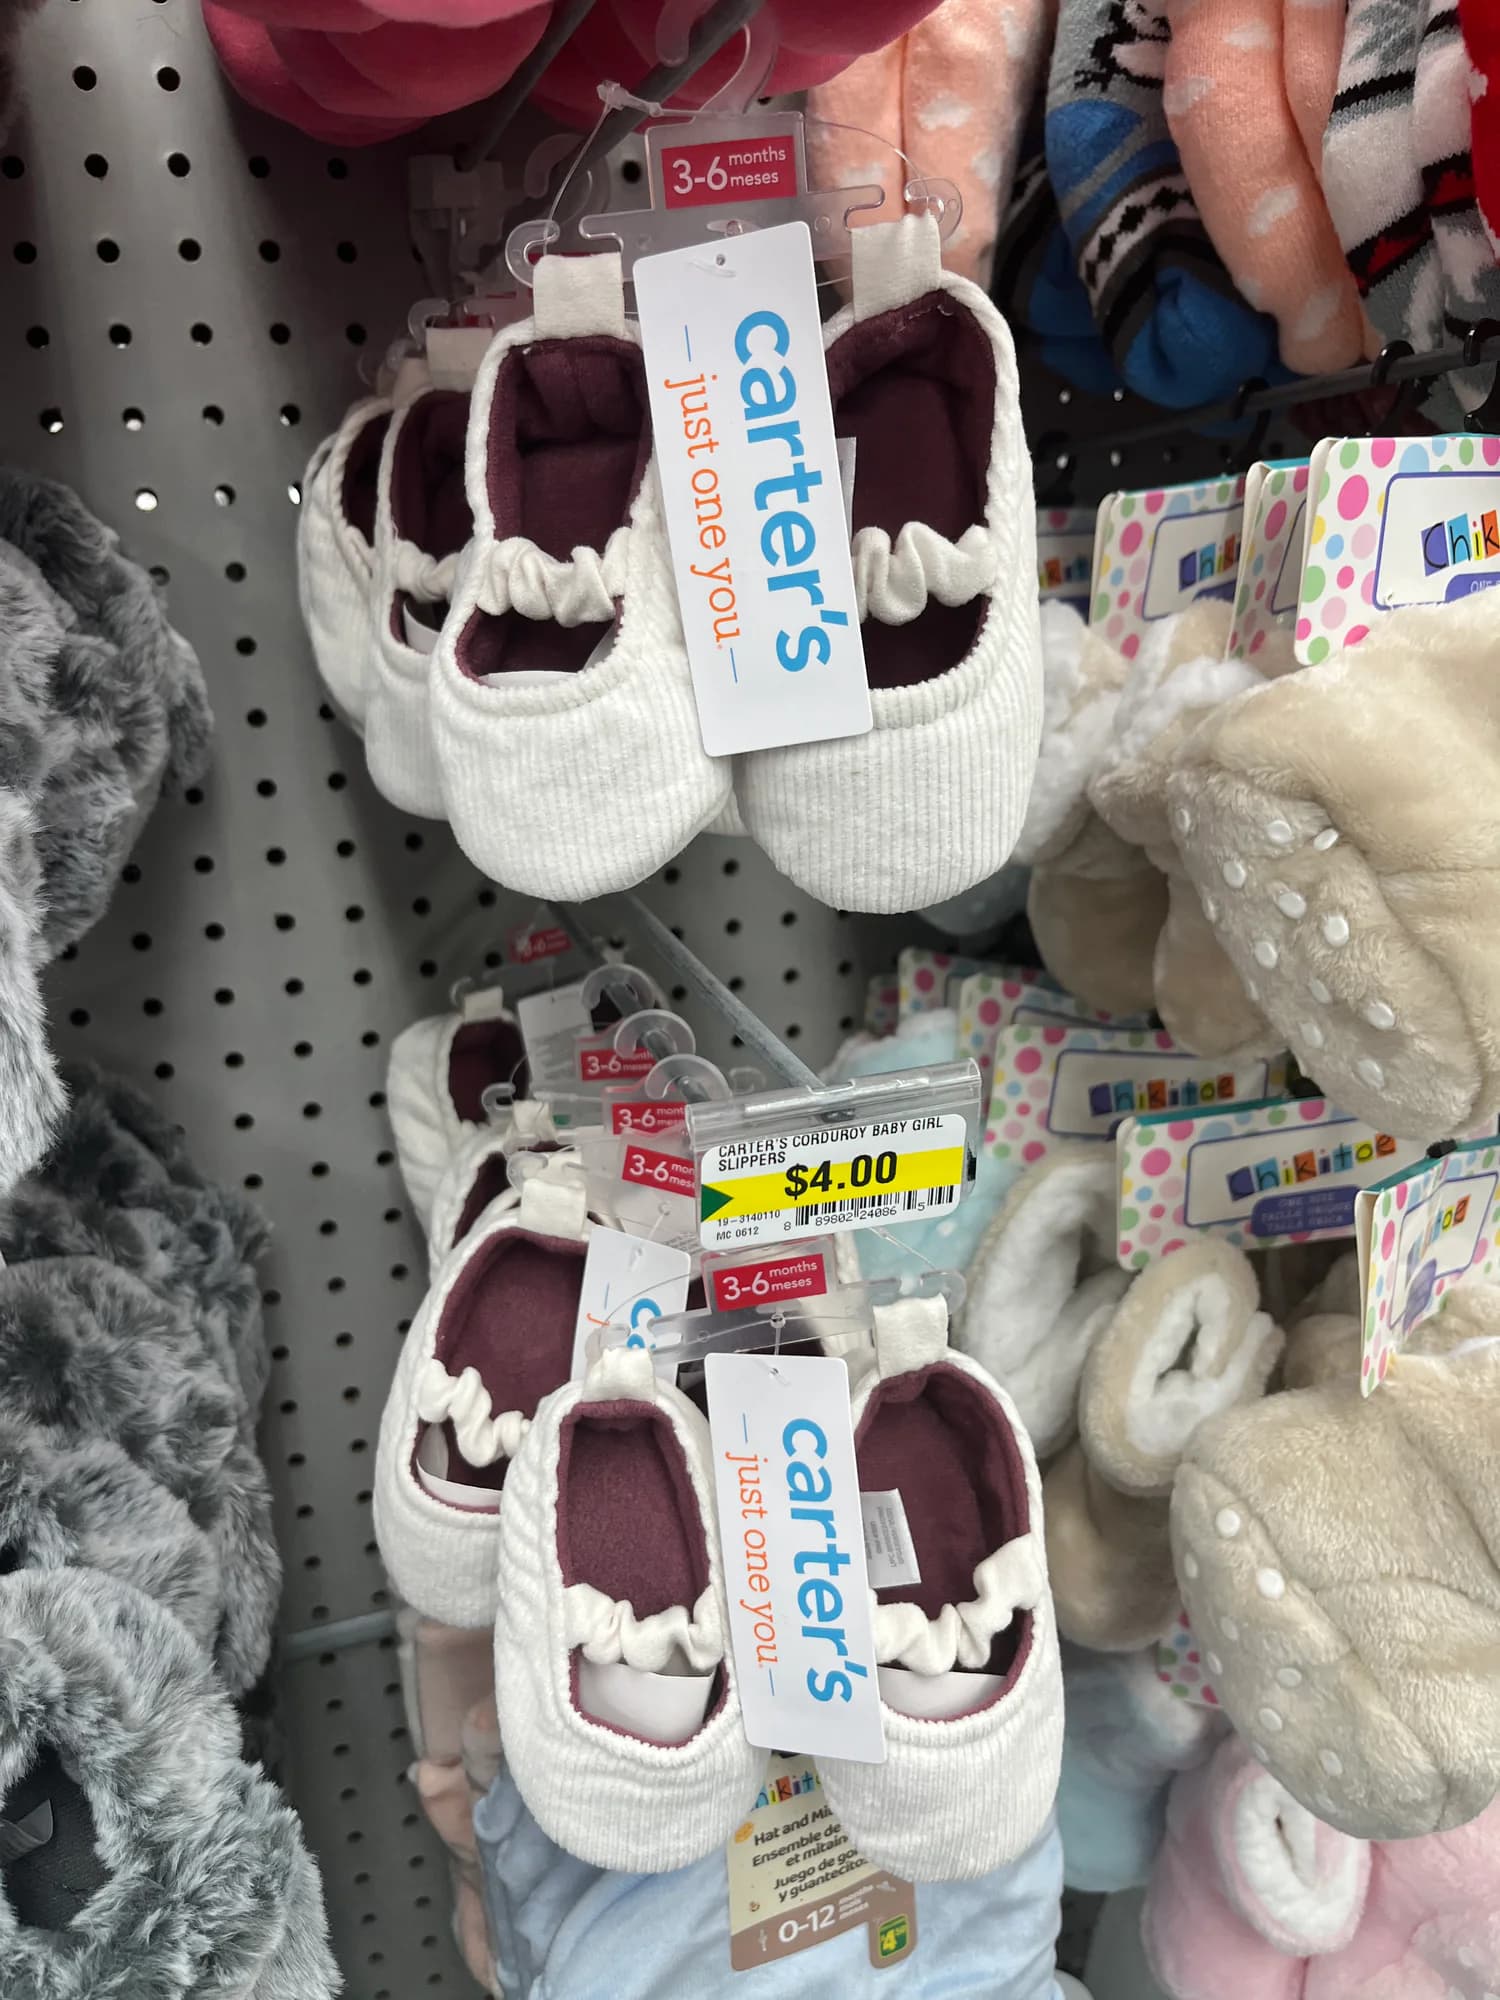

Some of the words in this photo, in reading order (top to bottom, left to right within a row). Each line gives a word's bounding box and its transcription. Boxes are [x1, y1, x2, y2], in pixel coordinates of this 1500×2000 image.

[729, 146, 786, 165] months
[671, 156, 728, 194] 3-6
[730, 169, 780, 187] meses
[664, 373, 720, 459] just
[734, 310, 849, 673] carter's
[691, 469, 727, 550] one
[1421, 510, 1500, 577] Chik
[586, 1055, 621, 1075] 3-6
[618, 1108, 656, 1128] 3-6
[719, 1137, 788, 1158] CARTER'S
[792, 1127, 868, 1148] CORDUROY
[872, 1121, 907, 1137] BABY
[912, 1116, 944, 1131] GIRL
[629, 1154, 669, 1182] 3-6
[671, 1163, 695, 1175] mon
[718, 1151, 786, 1172] SLIPPERS
[784, 1151, 898, 1200] $4.00
[783, 1221, 792, 1231] 8
[815, 1211, 853, 1226] 89802
[859, 1206, 897, 1220] 24086
[917, 1201, 926, 1212] 5
[716, 1230, 732, 1241] MC
[735, 1226, 759, 1238] 0612
[722, 1271, 770, 1301] 3-6
[769, 1261, 818, 1278] months
[771, 1278, 813, 1292] meses
[725, 1452, 769, 1520] just
[743, 1529, 771, 1593] one
[782, 1417, 868, 1704] carter's
[751, 1770, 822, 1812] ikit
[751, 1831, 822, 1868] Ensemble
[823, 1823, 842, 1837] de
[753, 1826, 780, 1846] Hat
[782, 1813, 810, 1834] and
[785, 1854, 801, 1868] et
[802, 1834, 849, 1861] mitain
[773, 1865, 816, 1890] Juego
[818, 1857, 835, 1871] de
[778, 1890, 788, 1903] y
[778, 1904, 837, 1943] 0-12
